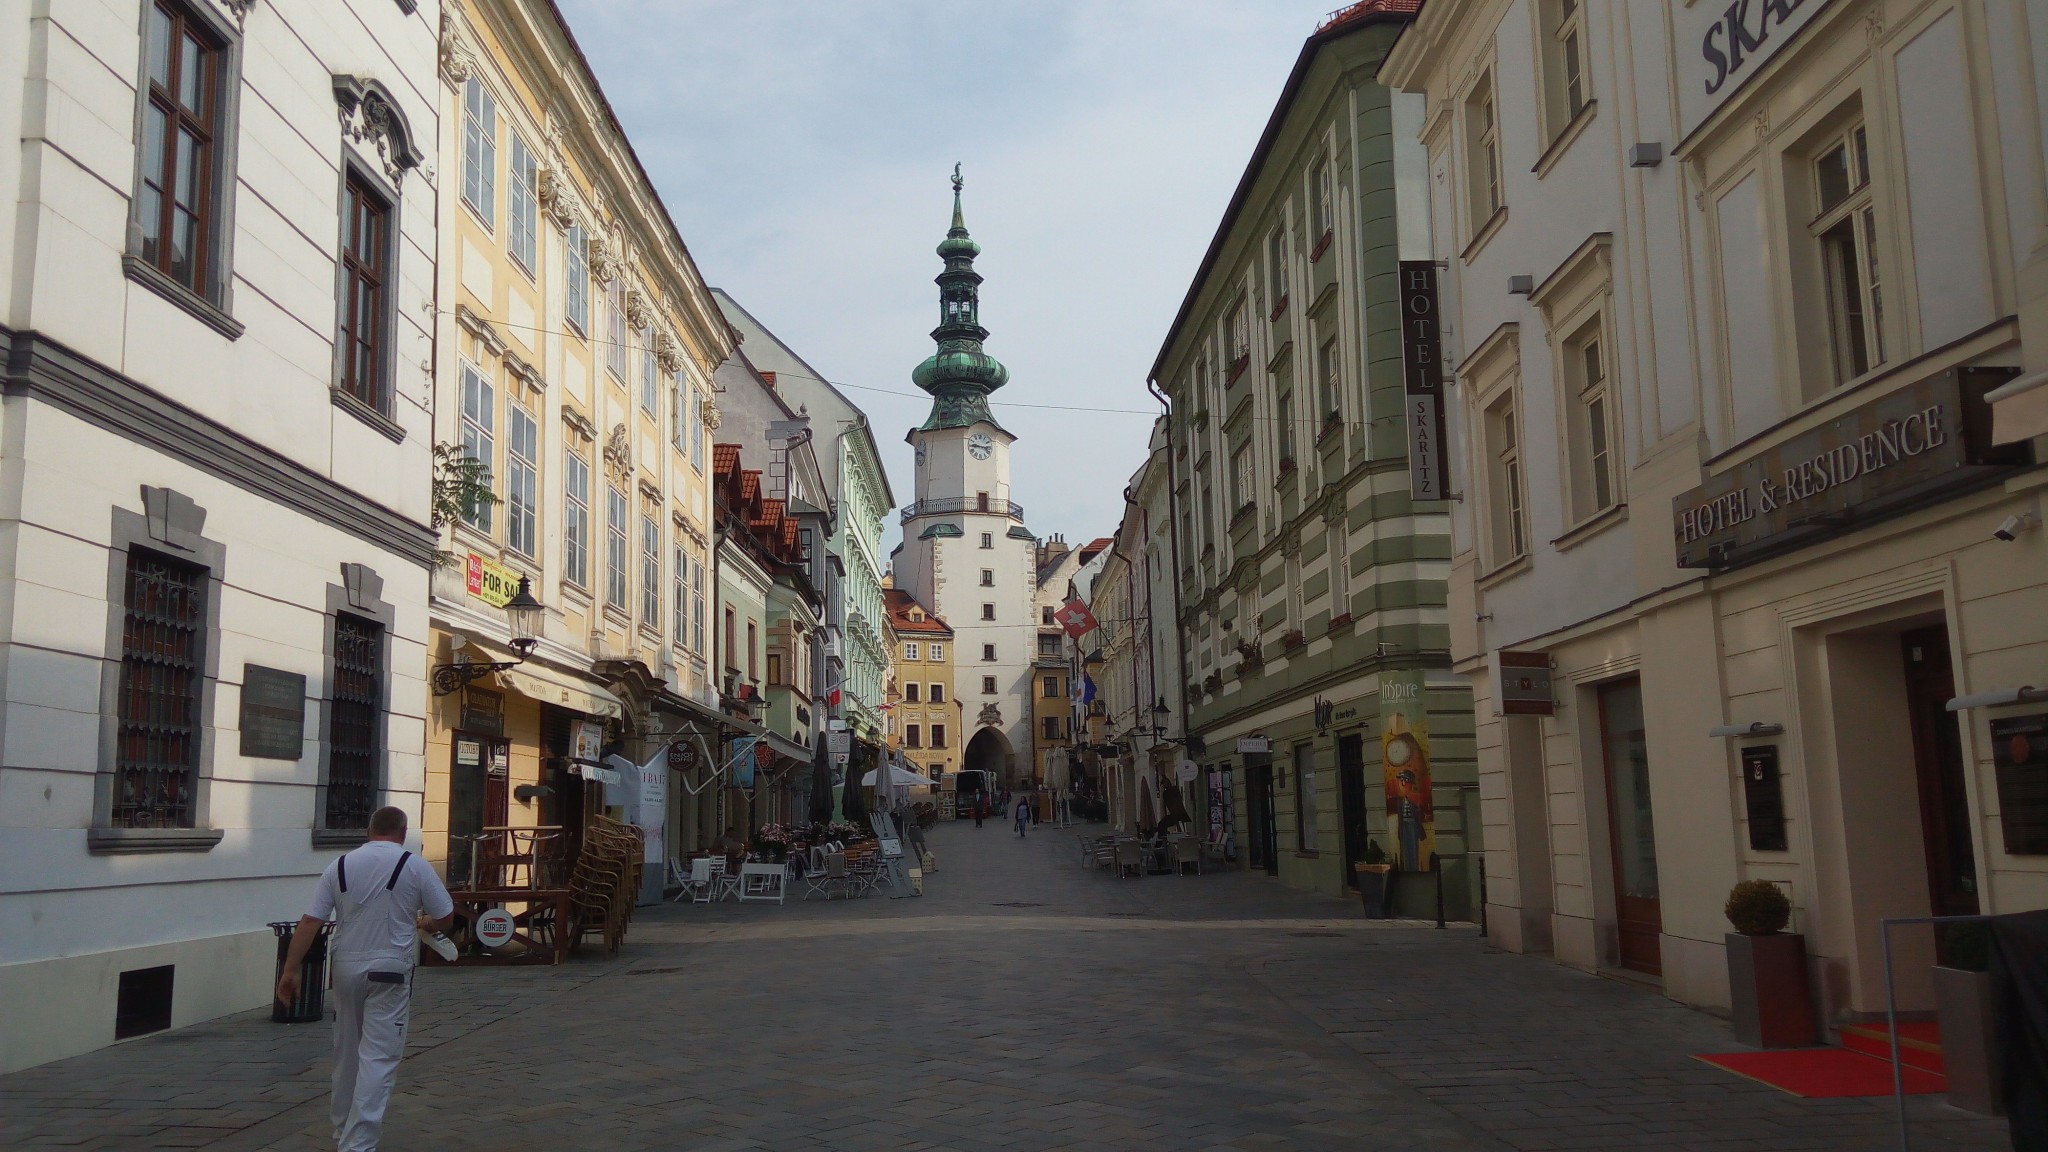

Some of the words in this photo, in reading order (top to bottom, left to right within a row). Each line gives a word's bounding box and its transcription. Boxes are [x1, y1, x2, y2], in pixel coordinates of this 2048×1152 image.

[1703, 0, 1802, 95] SKA
[1409, 270, 1434, 388] HOTEL
[1416, 401, 1432, 493] SKARITZ
[1681, 488, 1756, 544] HOTEL
[1759, 478, 1779, 514] &
[1783, 405, 1944, 505] RESIDENCE
[483, 570, 501, 594] FOR
[504, 581, 521, 599] SAL
